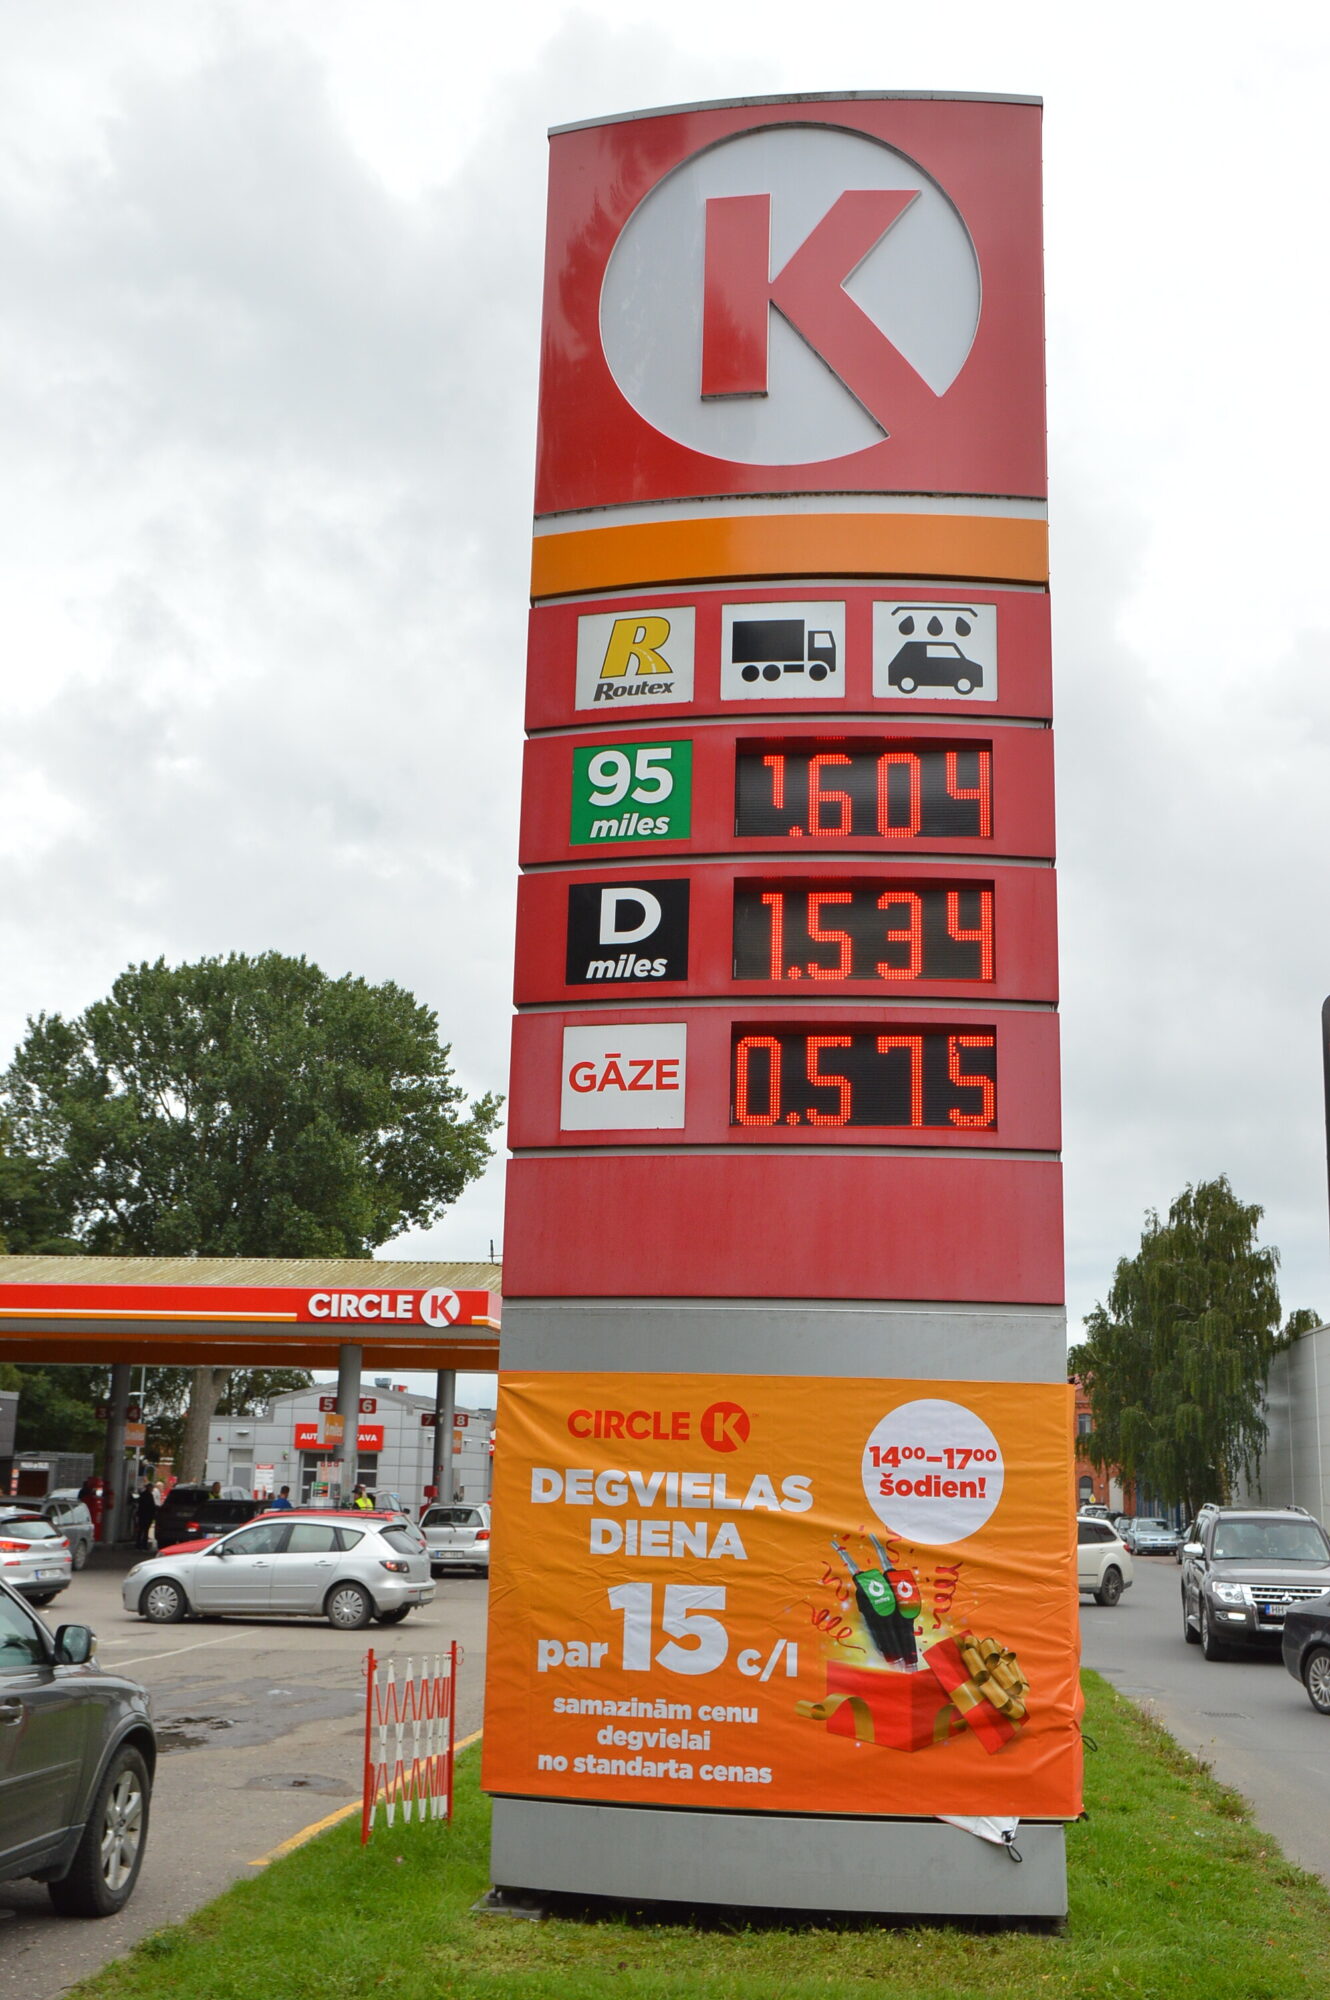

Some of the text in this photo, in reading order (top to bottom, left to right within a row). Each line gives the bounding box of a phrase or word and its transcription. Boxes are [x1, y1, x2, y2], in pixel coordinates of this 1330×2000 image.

[701, 188, 943, 440] K
[593, 680, 675, 701] Routex
[586, 747, 674, 806] 95
[763, 752, 990, 838] 1.604
[589, 812, 670, 839] miles
[599, 887, 662, 946] D
[761, 891, 993, 981] 1.534
[585, 954, 668, 980] miles
[568, 1053, 680, 1093] GĀZE
[735, 1035, 995, 1127] 0.575
[308, 1292, 454, 1325] CIRCLE K
[322, 1398, 334, 1411] 5
[362, 1400, 373, 1413] 6
[424, 1413, 433, 1426] 7
[456, 1414, 466, 1427] 8
[567, 1409, 747, 1451] CIRCLE K
[530, 1467, 814, 1513] DEGVIELAS
[879, 1472, 987, 1499] šodien!
[589, 1518, 748, 1561] DIENA
[537, 1582, 799, 1683] par 15 c/l
[554, 1695, 759, 1724] samazinām cenu
[596, 1725, 711, 1752] degvielai
[537, 1754, 773, 1784] no standarta cenas
